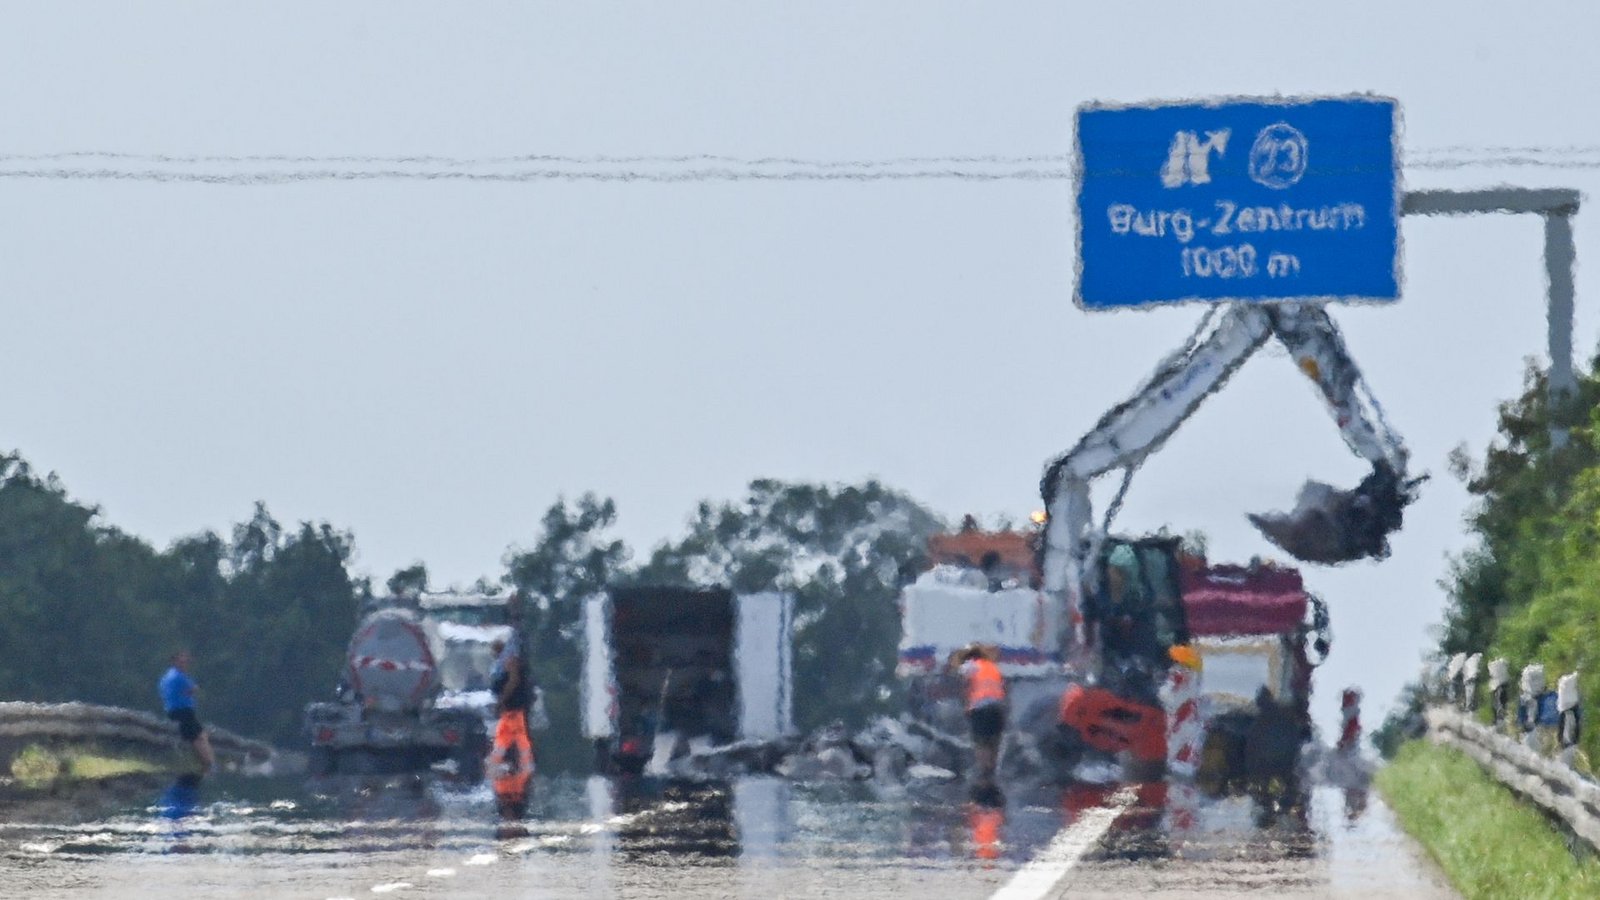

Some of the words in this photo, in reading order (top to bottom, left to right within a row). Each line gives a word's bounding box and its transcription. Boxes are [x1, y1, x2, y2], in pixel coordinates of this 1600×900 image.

[1108, 201, 1365, 242] Burg-Zentrum
[1181, 244, 1257, 278] 1000
[1266, 252, 1300, 278] m
